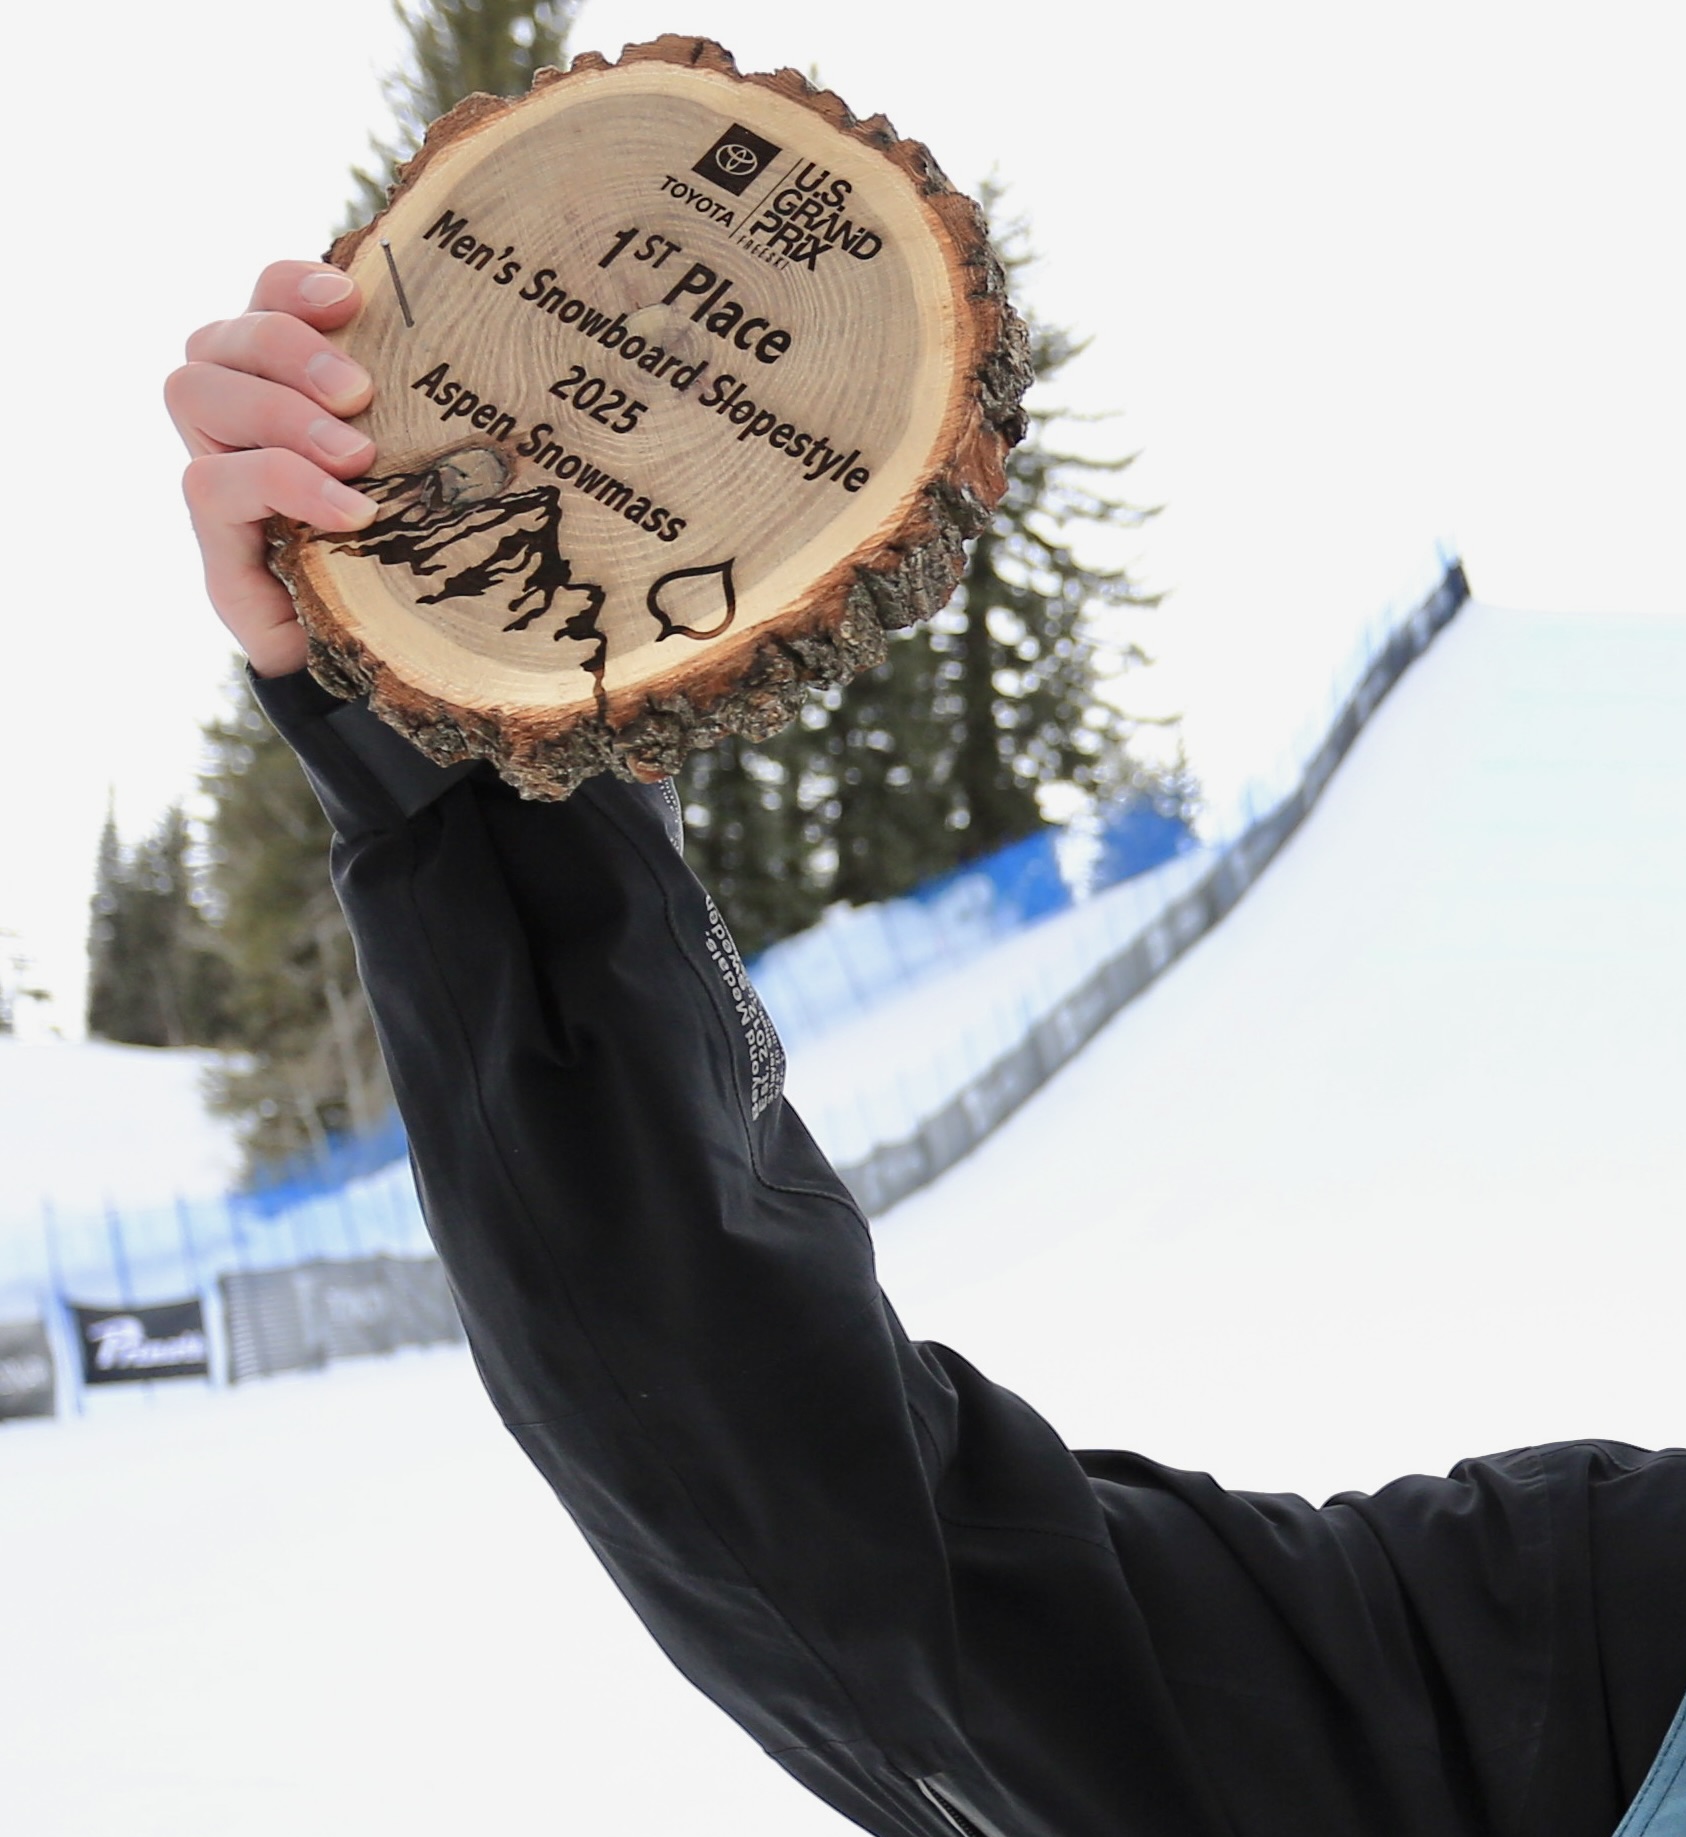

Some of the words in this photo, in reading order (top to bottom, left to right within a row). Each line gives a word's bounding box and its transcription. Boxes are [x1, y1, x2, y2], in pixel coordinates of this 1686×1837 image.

[660, 175, 736, 228] TOYOTA
[795, 162, 852, 212] U.S.
[736, 235, 790, 271] FREESKI
[773, 188, 882, 260] GRAND
[598, 228, 681, 270] 1ST
[662, 262, 792, 364] Place
[422, 210, 521, 285] Men's
[519, 269, 709, 393] Snowboard
[698, 374, 870, 493] Slopestyle
[549, 365, 649, 434] 2025
[411, 363, 517, 441] Aspen
[516, 424, 687, 543] Snowmass
[704, 930, 749, 1026] Medals.
[748, 1003, 768, 1062] 2012
[745, 1029, 759, 1122] Beyond
